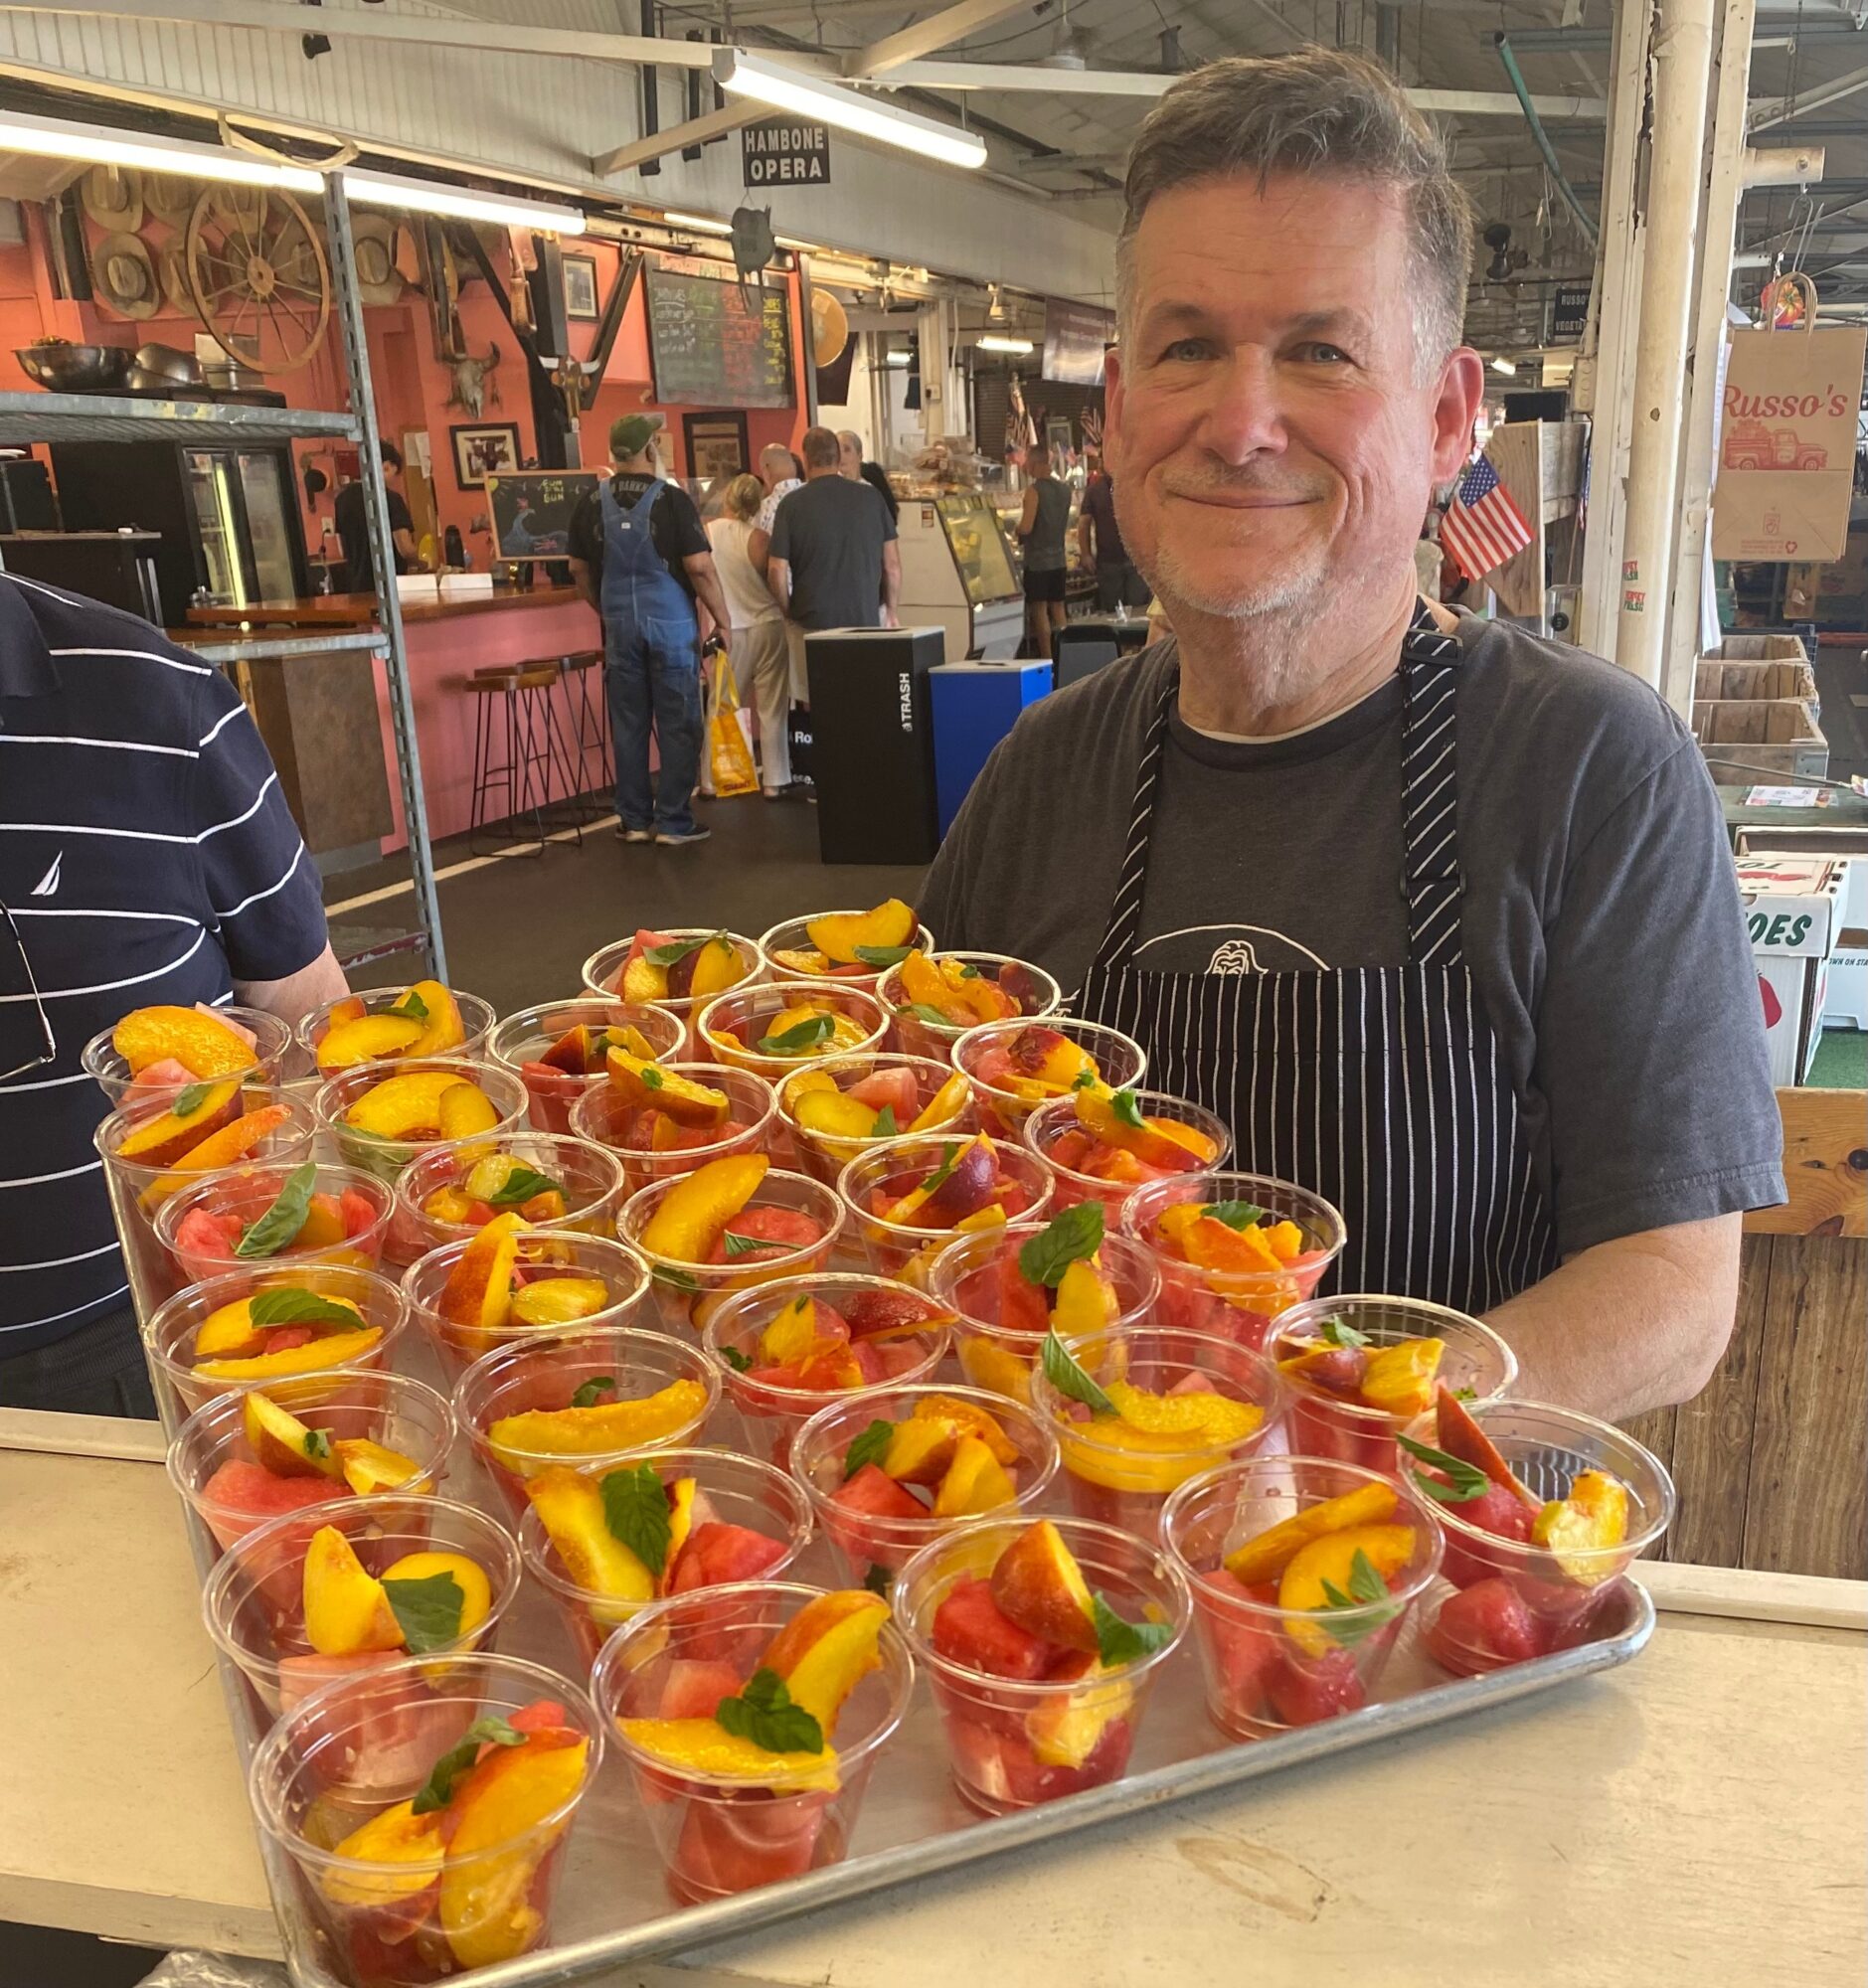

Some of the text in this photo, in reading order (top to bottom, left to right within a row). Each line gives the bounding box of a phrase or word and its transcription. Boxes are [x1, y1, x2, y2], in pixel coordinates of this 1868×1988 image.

[746, 126, 824, 153] HAMBONE
[751, 156, 822, 181] OPERA
[1561, 294, 1590, 306] RUSSO'
[1555, 319, 1584, 331] VEGETA
[1723, 384, 1848, 418] Russo's
[899, 673, 912, 722] TRASH
[1748, 912, 1812, 946] OES
